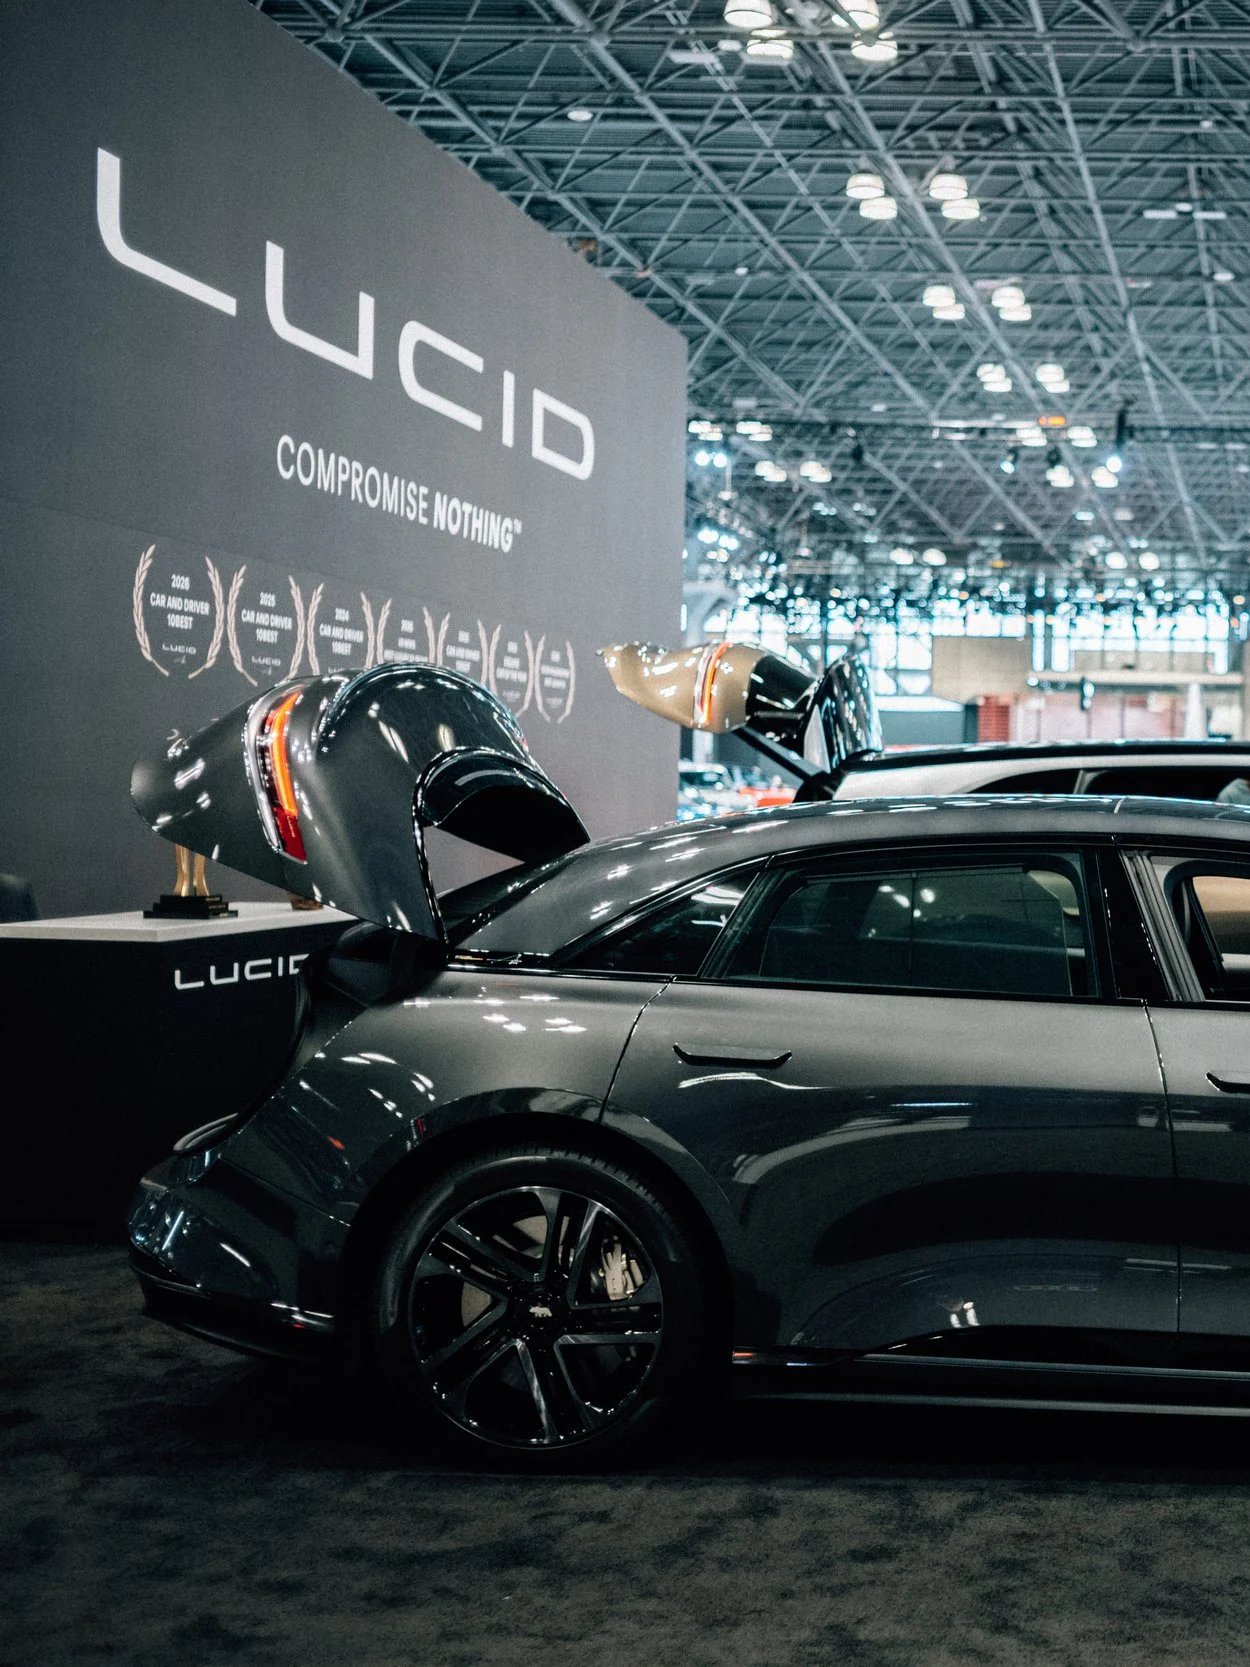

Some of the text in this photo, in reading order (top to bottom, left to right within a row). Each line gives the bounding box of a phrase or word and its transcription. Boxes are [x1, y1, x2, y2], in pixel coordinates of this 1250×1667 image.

[97, 147, 595, 481] LUCID
[277, 434, 429, 526] COMPROMISE
[150, 592, 210, 616] CAR AND DRIVER
[241, 608, 293, 631] CAR AND DRIVER
